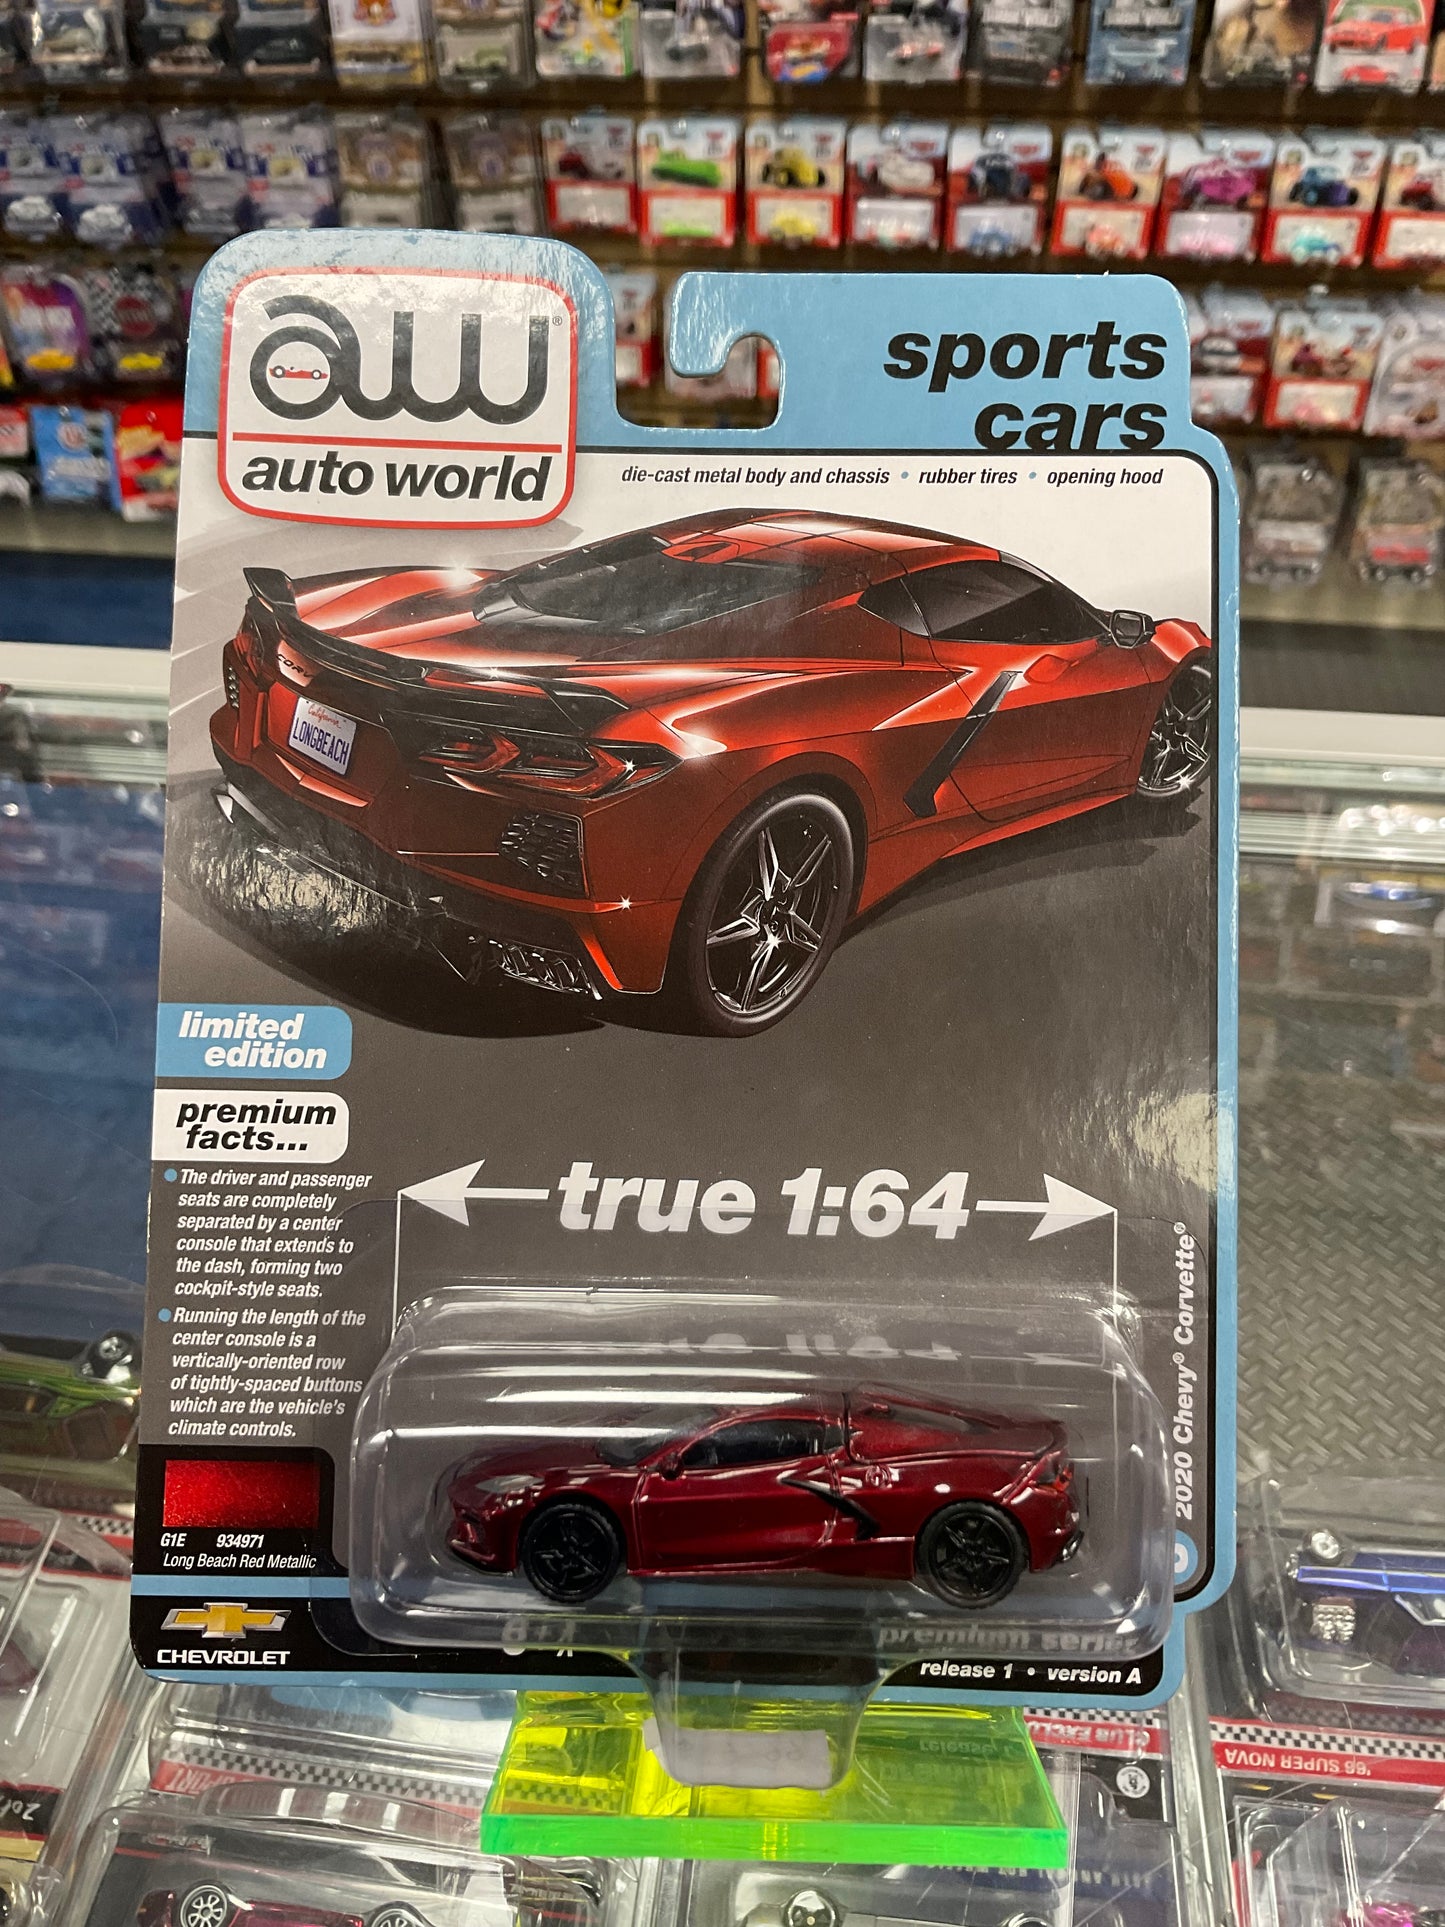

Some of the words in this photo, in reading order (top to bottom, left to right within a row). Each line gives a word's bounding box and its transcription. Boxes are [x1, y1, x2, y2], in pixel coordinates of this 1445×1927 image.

[883, 321, 1167, 393] sports
[974, 401, 1167, 450] cars
[241, 450, 375, 495] auto
[385, 455, 554, 502] world
[621, 466, 691, 482] die-cast
[694, 467, 742, 484] metal
[745, 467, 786, 487] body
[790, 468, 822, 484] and
[825, 468, 890, 484] chassis
[918, 468, 976, 484] rubber
[980, 468, 1017, 484] tires
[1047, 469, 1117, 488] opening
[1120, 468, 1164, 484] hood
[292, 717, 350, 765] LONGBEACH
[178, 1011, 305, 1040] limited
[204, 1041, 327, 1069] edition
[176, 1098, 336, 1128] premium
[186, 1124, 308, 1151] facts...
[180, 1169, 207, 1185] The
[210, 1170, 256, 1186] driver
[259, 1171, 289, 1186] and
[290, 1174, 372, 1191] passenger
[178, 1192, 220, 1207] seats
[223, 1194, 249, 1207] are
[251, 1193, 337, 1211] completely
[557, 1161, 758, 1235] true
[780, 1167, 971, 1239] 1:64
[177, 1214, 254, 1231] separated
[257, 1215, 277, 1233] by
[279, 1218, 289, 1231] a
[292, 1216, 343, 1231] center
[176, 1236, 237, 1251] console
[240, 1237, 271, 1252] that
[274, 1238, 335, 1253] extends
[338, 1238, 354, 1253] to
[176, 1257, 201, 1273] the
[204, 1258, 246, 1276] dash,
[249, 1259, 311, 1277] forming
[314, 1261, 343, 1276] two
[174, 1280, 274, 1299] cockpit-style
[277, 1282, 323, 1297] seats.
[173, 1307, 239, 1326] Running
[241, 1308, 266, 1324] the
[269, 1309, 319, 1328] length
[322, 1309, 338, 1326] of
[340, 1310, 366, 1326] the
[172, 1331, 223, 1346] center
[225, 1331, 286, 1347] console
[288, 1331, 303, 1347] is
[306, 1334, 316, 1347] a
[172, 1352, 313, 1371] vertically-oriented
[315, 1356, 346, 1370] row
[170, 1374, 189, 1390] of
[190, 1374, 302, 1394] tightly-spaced
[303, 1377, 363, 1393] buttons
[170, 1397, 217, 1413] which
[220, 1401, 246, 1414] are
[249, 1399, 274, 1415] the
[278, 1398, 346, 1415] vehicle's
[168, 1419, 226, 1436] climate
[229, 1421, 296, 1437] controls.
[1175, 1450, 1193, 1520] 2020
[160, 1533, 187, 1547] G1E
[216, 1533, 265, 1549] 934971
[163, 1553, 195, 1570] Long
[197, 1553, 237, 1569] Beach
[239, 1554, 266, 1569] Red
[267, 1554, 316, 1569] Metallic
[878, 1623, 1031, 1648] premium
[156, 1649, 291, 1665] CHEVROLET
[920, 1660, 995, 1678] release
[1003, 1663, 1013, 1679] 1
[1047, 1667, 1122, 1683] version
[1125, 1668, 1142, 1684] A
[1095, 1727, 1150, 1750] CLUB
[1224, 1748, 1275, 1767] NOVA
[1280, 1755, 1339, 1773] SUPER
